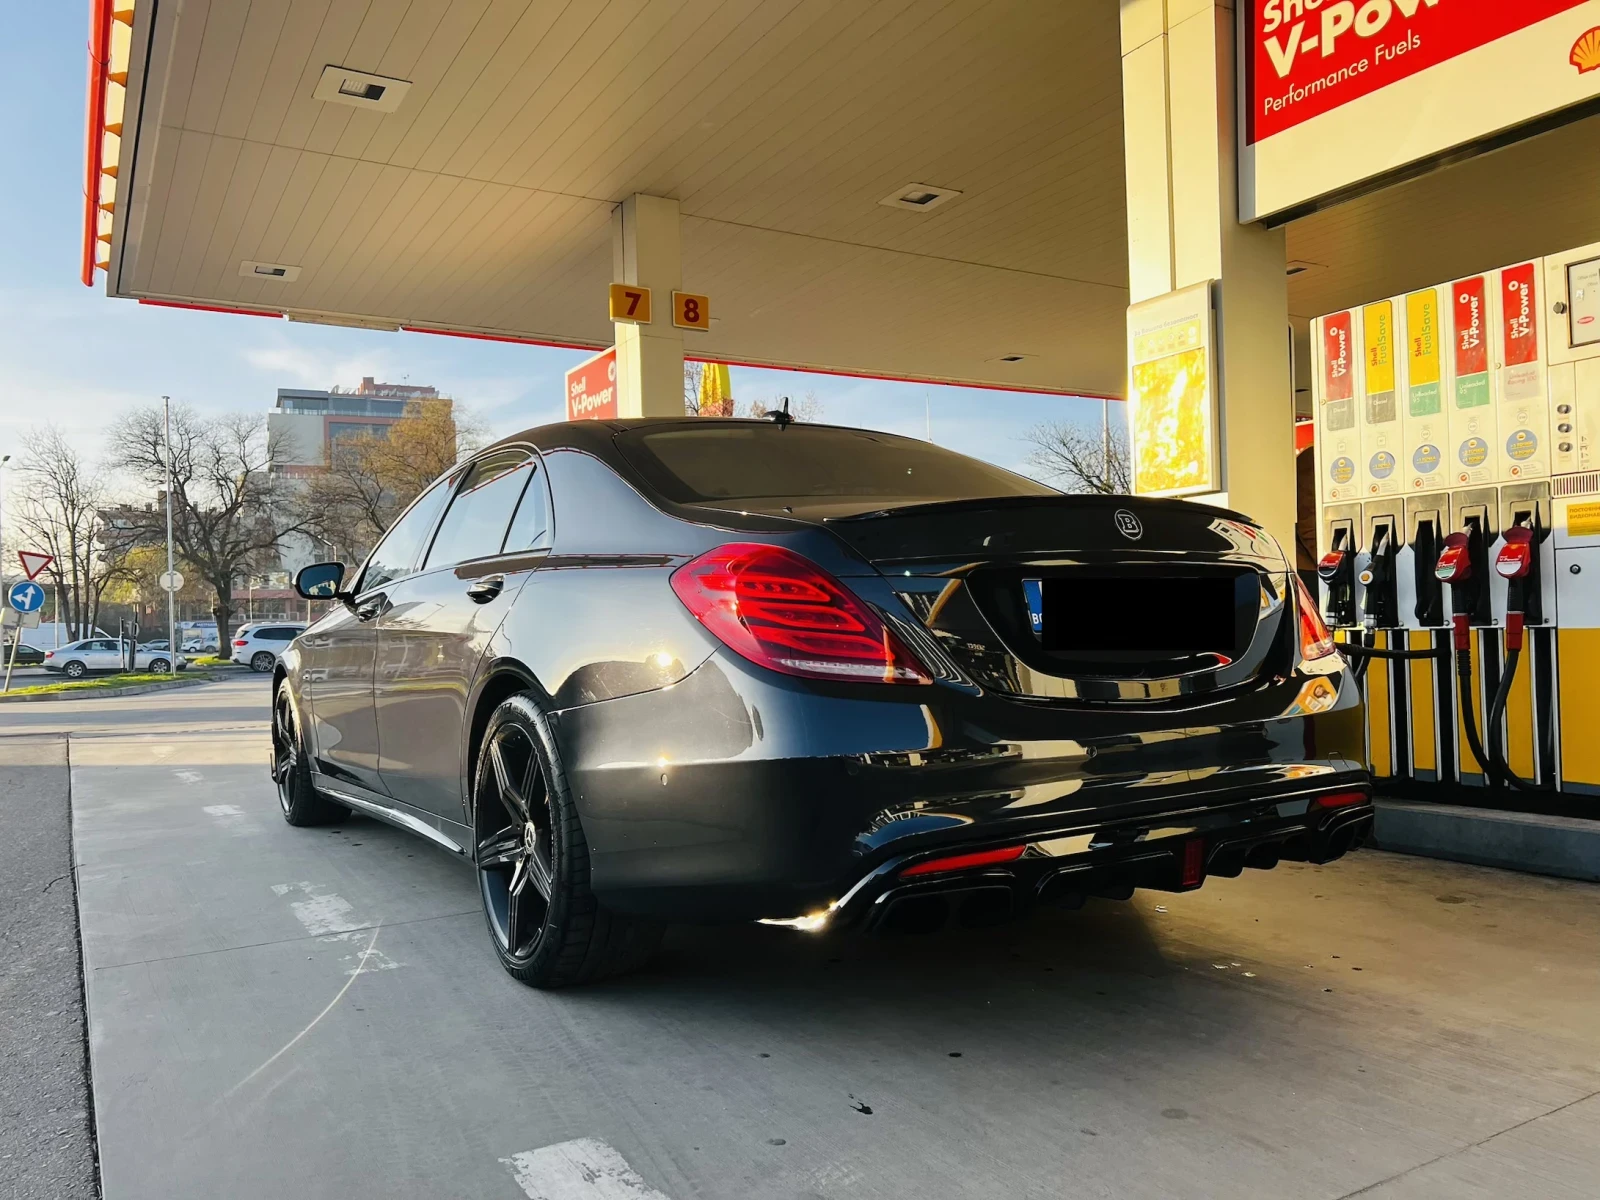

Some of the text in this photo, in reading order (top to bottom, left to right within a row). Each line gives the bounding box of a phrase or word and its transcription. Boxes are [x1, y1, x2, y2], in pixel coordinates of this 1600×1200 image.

[1264, 29, 1421, 116] Performance Fuels
[625, 292, 642, 316] 7
[683, 298, 700, 323] 8
[1519, 283, 1530, 338] V-Power
[1421, 303, 1432, 356] FuelSave
[1469, 295, 1480, 348] V-Power
[1510, 318, 1519, 339] Shell
[1377, 314, 1387, 365] FuelSave
[1414, 337, 1422, 357] Shell
[1461, 329, 1470, 350] Shell
[1337, 329, 1347, 377] V-Power
[1370, 347, 1378, 366] Shell
[571, 376, 586, 397] Shell
[1412, 387, 1438, 399] Unleaded
[1459, 378, 1486, 390] Unleaded
[571, 386, 613, 417] V-Power
